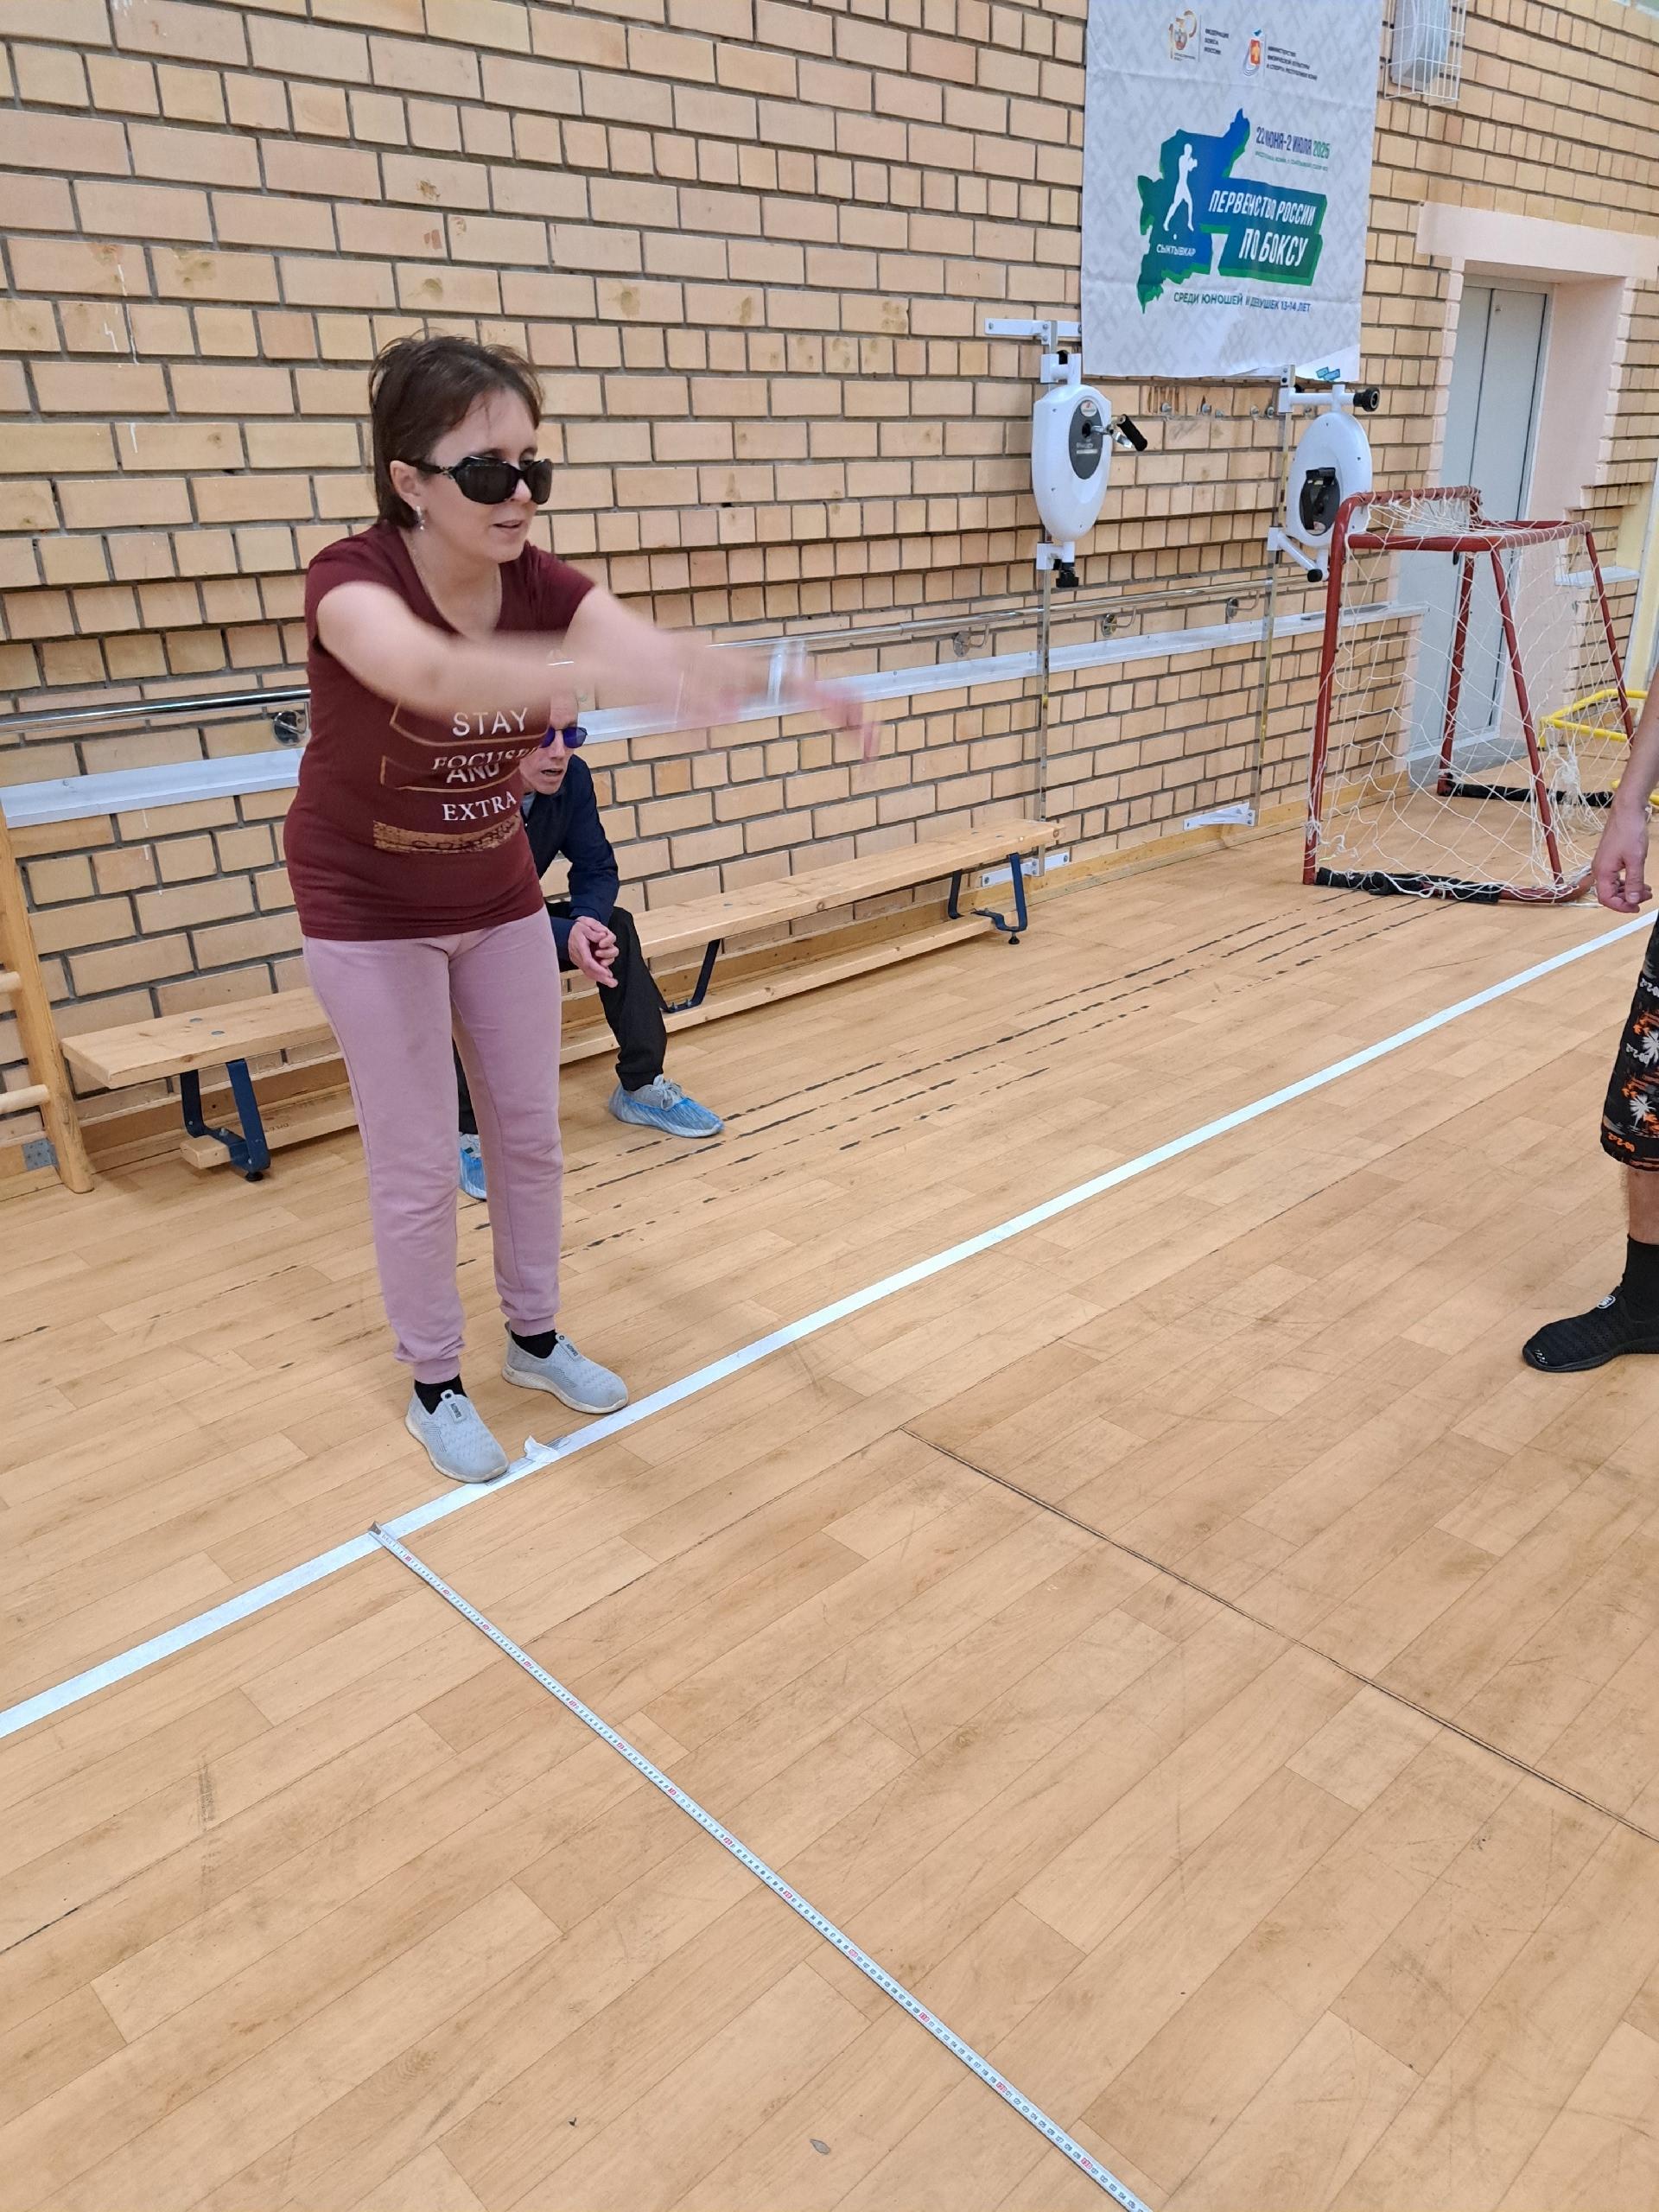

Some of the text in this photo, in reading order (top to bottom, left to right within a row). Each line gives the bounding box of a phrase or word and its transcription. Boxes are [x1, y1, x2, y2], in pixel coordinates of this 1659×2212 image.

[1256, 126, 1265, 144] 22
[1208, 189, 1318, 226] ПЕРВЕНСТВО РОССИИ
[1156, 244, 1197, 257] СЫКТЫВКАР
[1238, 227, 1309, 267] ПО БОКСУ
[1173, 292, 1199, 304] СРЕДИ
[1201, 292, 1243, 306] ЮНОШЕЙ
[1296, 302, 1312, 312] ЛЕТ
[452, 707, 528, 737] STAY
[442, 791, 518, 822] EXTRA
